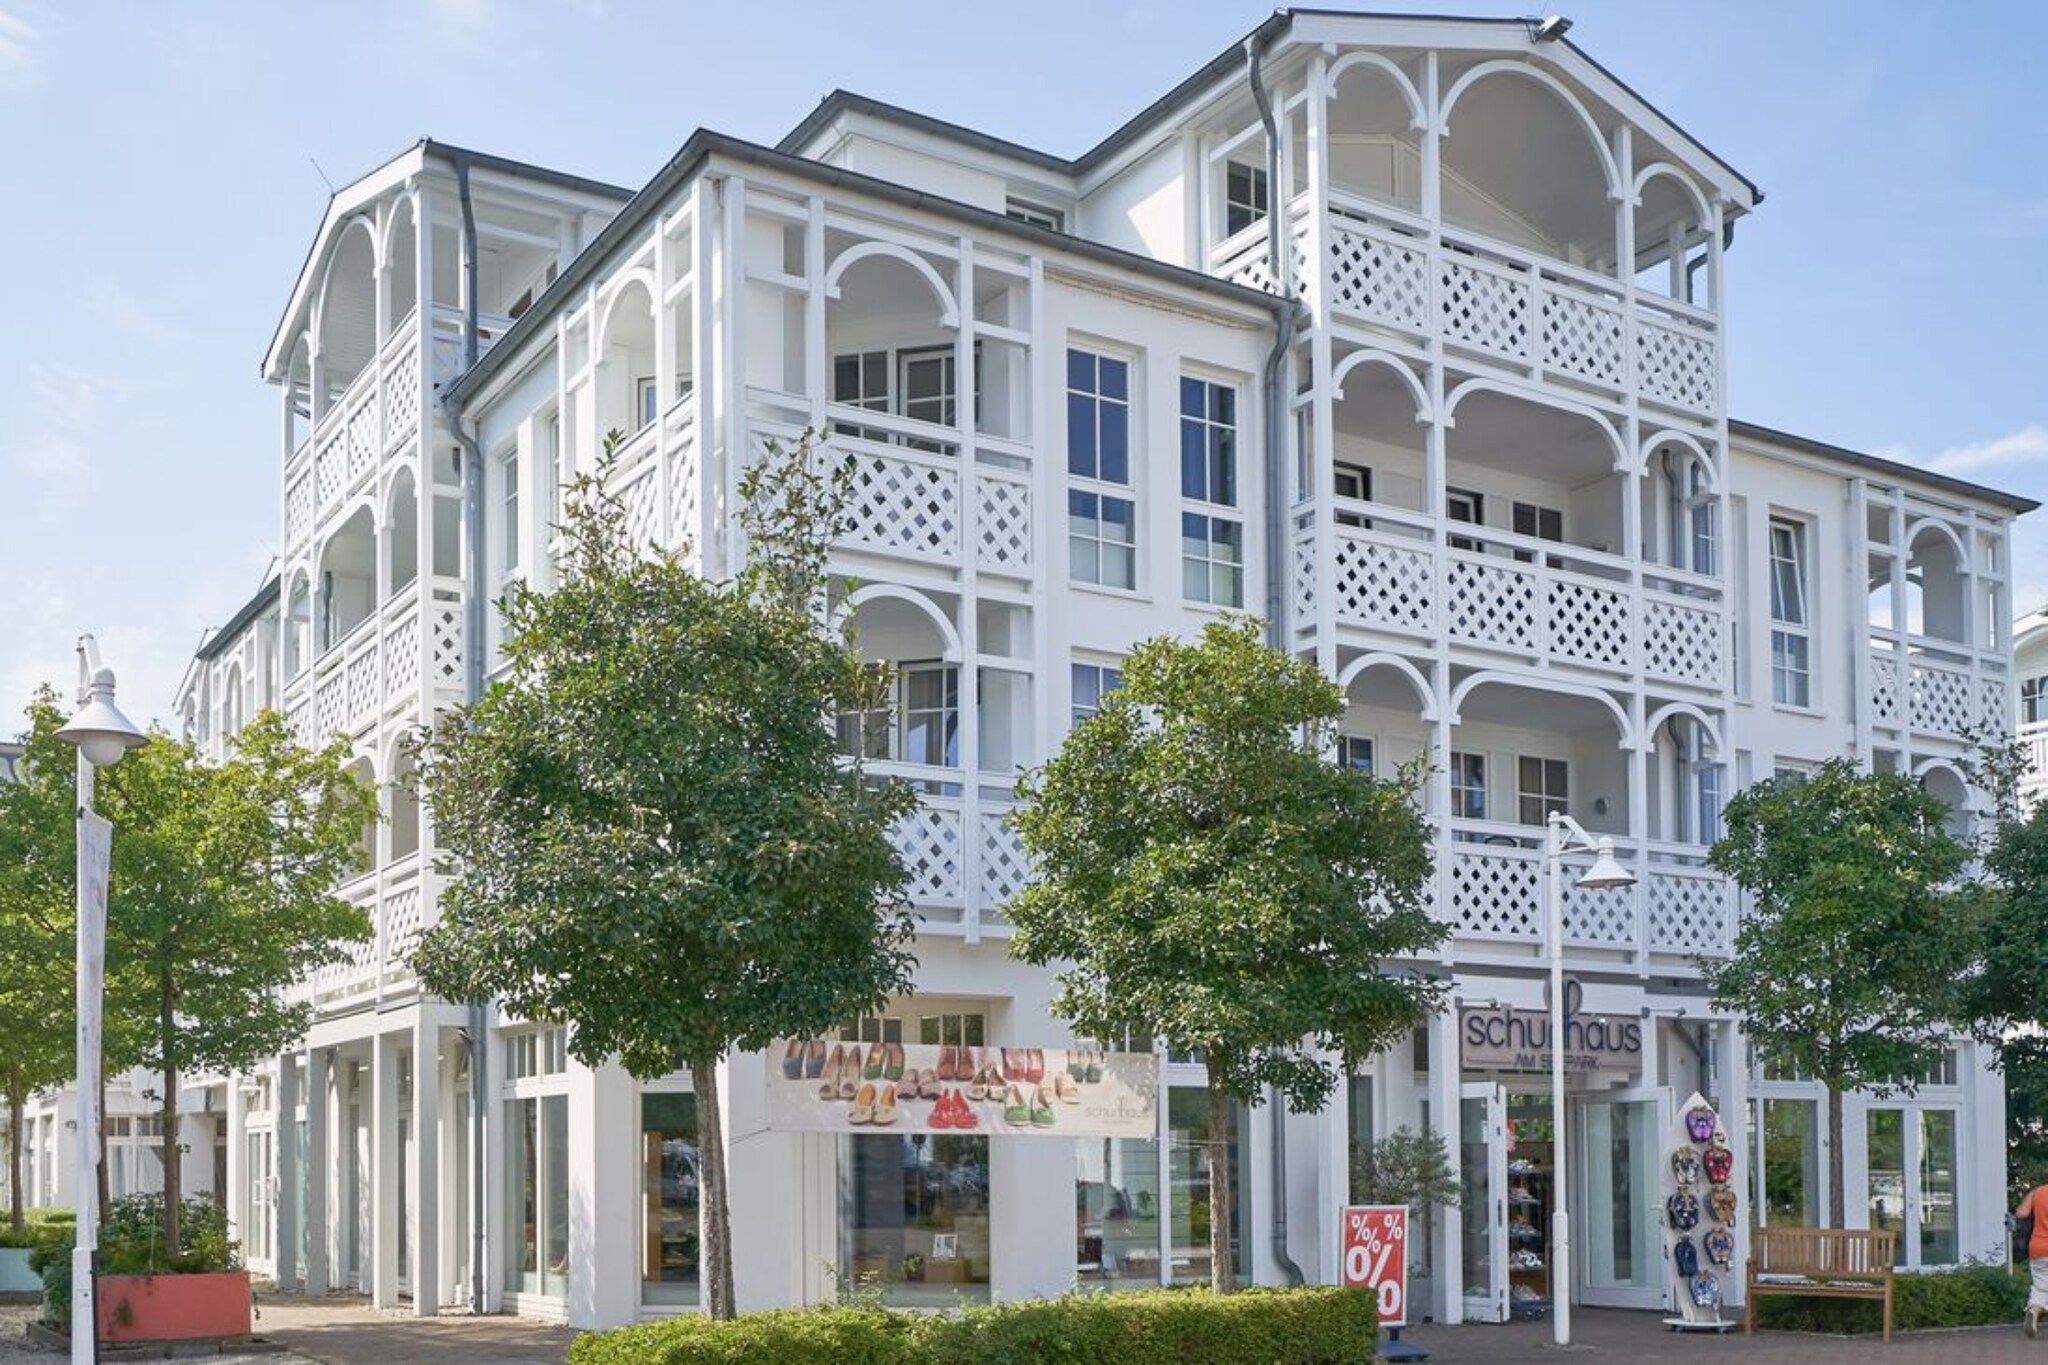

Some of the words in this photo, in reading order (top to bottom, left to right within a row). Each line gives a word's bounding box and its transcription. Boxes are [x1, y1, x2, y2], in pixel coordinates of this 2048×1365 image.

[1513, 1053, 1536, 1069] AM
[1540, 1053, 1599, 1070] SPARK
[1346, 1244, 1401, 1315] %
